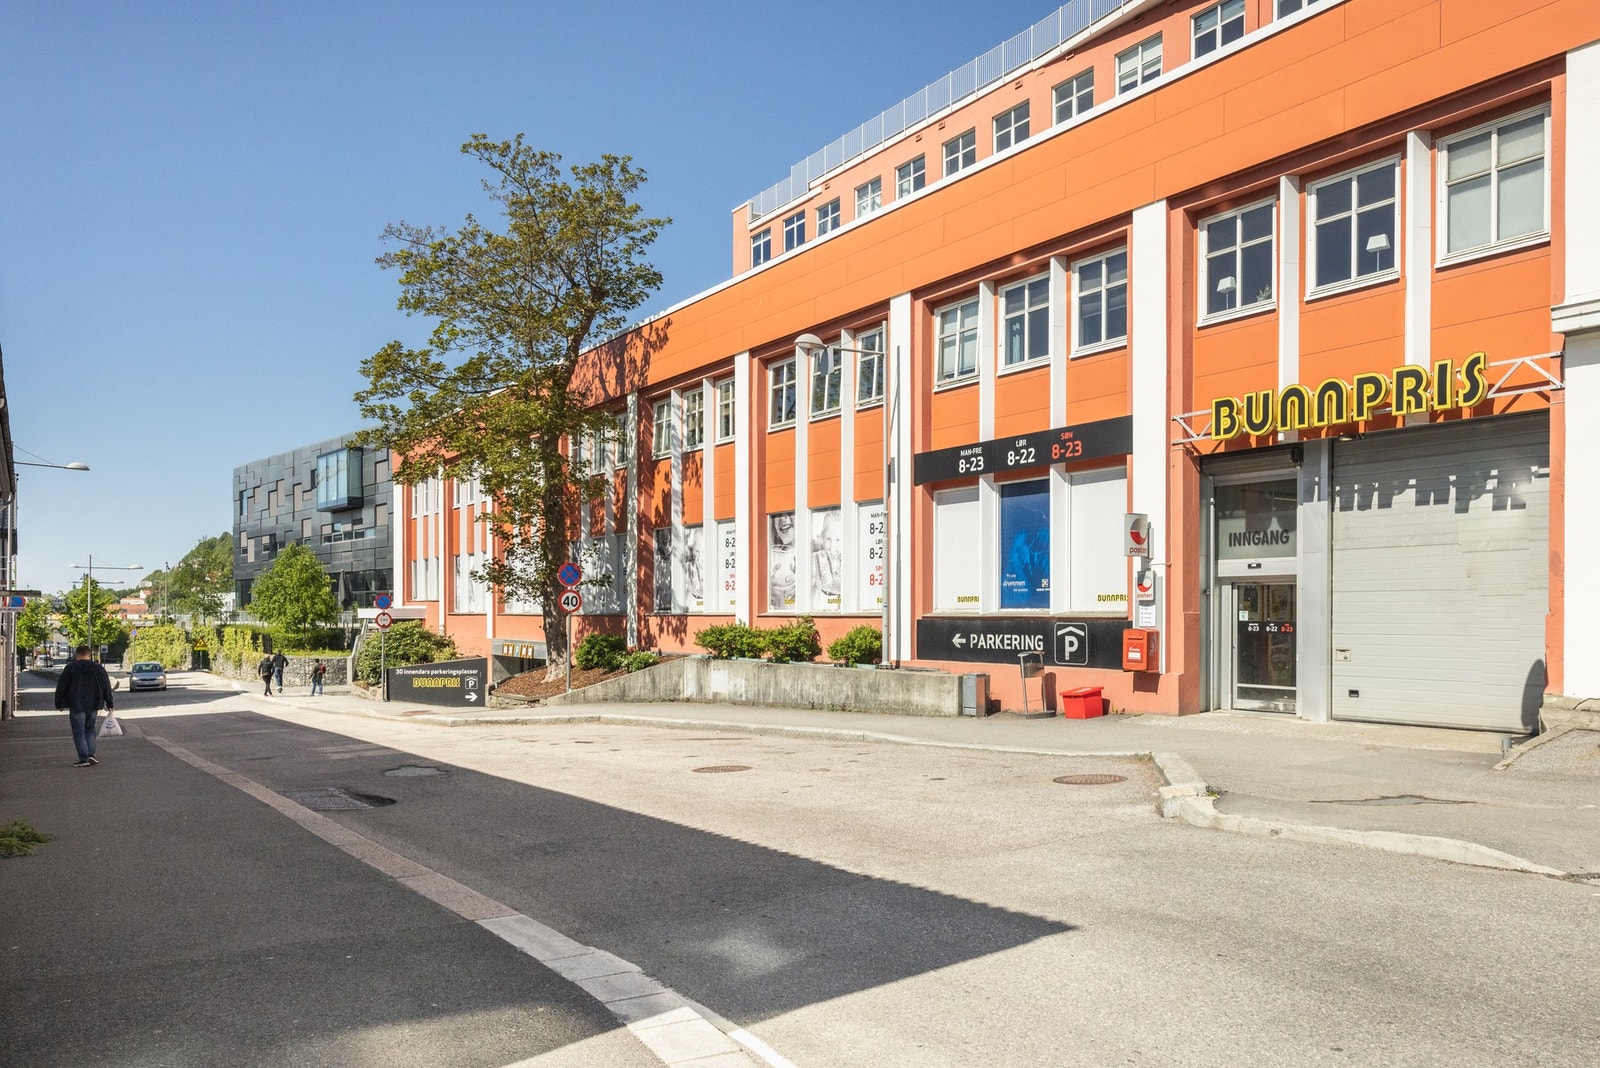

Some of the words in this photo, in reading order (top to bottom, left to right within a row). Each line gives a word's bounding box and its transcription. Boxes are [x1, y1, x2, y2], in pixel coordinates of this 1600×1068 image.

[1211, 351, 1487, 440] BUNNPRIS
[1016, 439, 1027, 447] LØR
[1060, 431, 1073, 440] SØN
[960, 447, 982, 457] MAN-FRE
[1007, 447, 1036, 465] 8-22
[1051, 440, 1083, 459] 8-23
[958, 456, 984, 473] 8-23
[1229, 529, 1290, 547] INNGANG
[562, 595, 578, 607] 40
[970, 633, 1044, 650] PARKERING
[412, 677, 461, 688] BUNNPRIS
